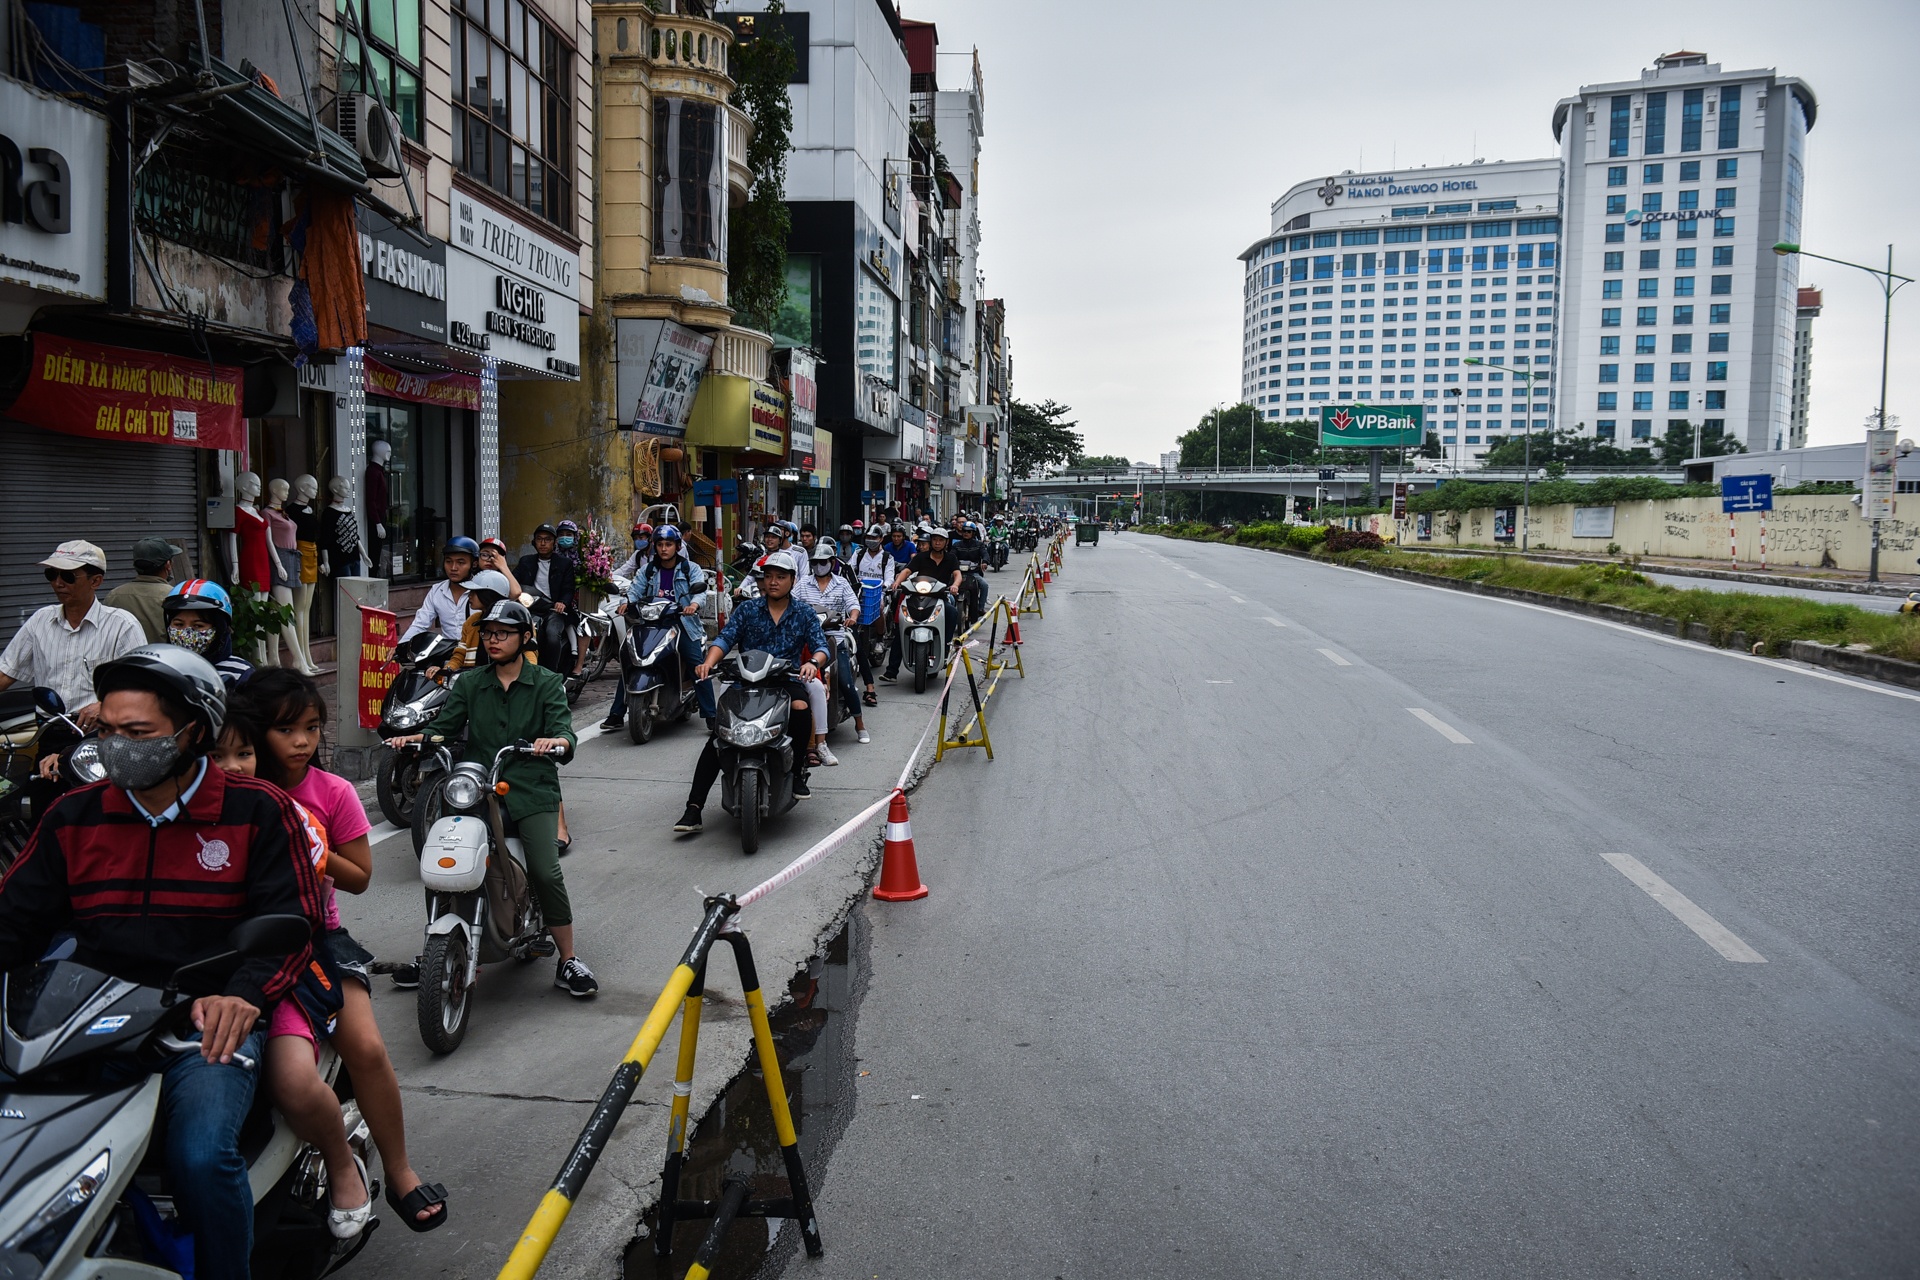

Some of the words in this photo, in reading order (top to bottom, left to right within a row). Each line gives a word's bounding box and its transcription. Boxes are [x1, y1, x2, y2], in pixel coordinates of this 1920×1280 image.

[1348, 187, 1384, 199] HANOI
[1388, 183, 1438, 196] DAEWOO
[1442, 180, 1478, 192] HOTEL
[460, 202, 473, 225] NHÀ
[460, 225, 474, 247] MAY
[482, 218, 526, 269] TRIỆU
[528, 242, 570, 288] TRUNG
[375, 240, 445, 302] FASHION
[453, 322, 471, 346] 429
[487, 311, 520, 338] MEN'S
[519, 323, 556, 350] FASHION
[621, 334, 645, 357] 431
[43, 346, 85, 386] ĐIỂM
[88, 351, 108, 389] XẢ
[111, 361, 147, 394] HÀNG
[150, 365, 184, 398] QUẦN
[187, 371, 204, 401] ÁO
[95, 401, 121, 432] GIÁ
[124, 400, 147, 435] CHỈ
[150, 405, 172, 436] TỪ
[1355, 414, 1417, 430] VPBank
[369, 614, 388, 637] HÀNG
[362, 643, 376, 661] THU
[368, 699, 384, 716] 100
